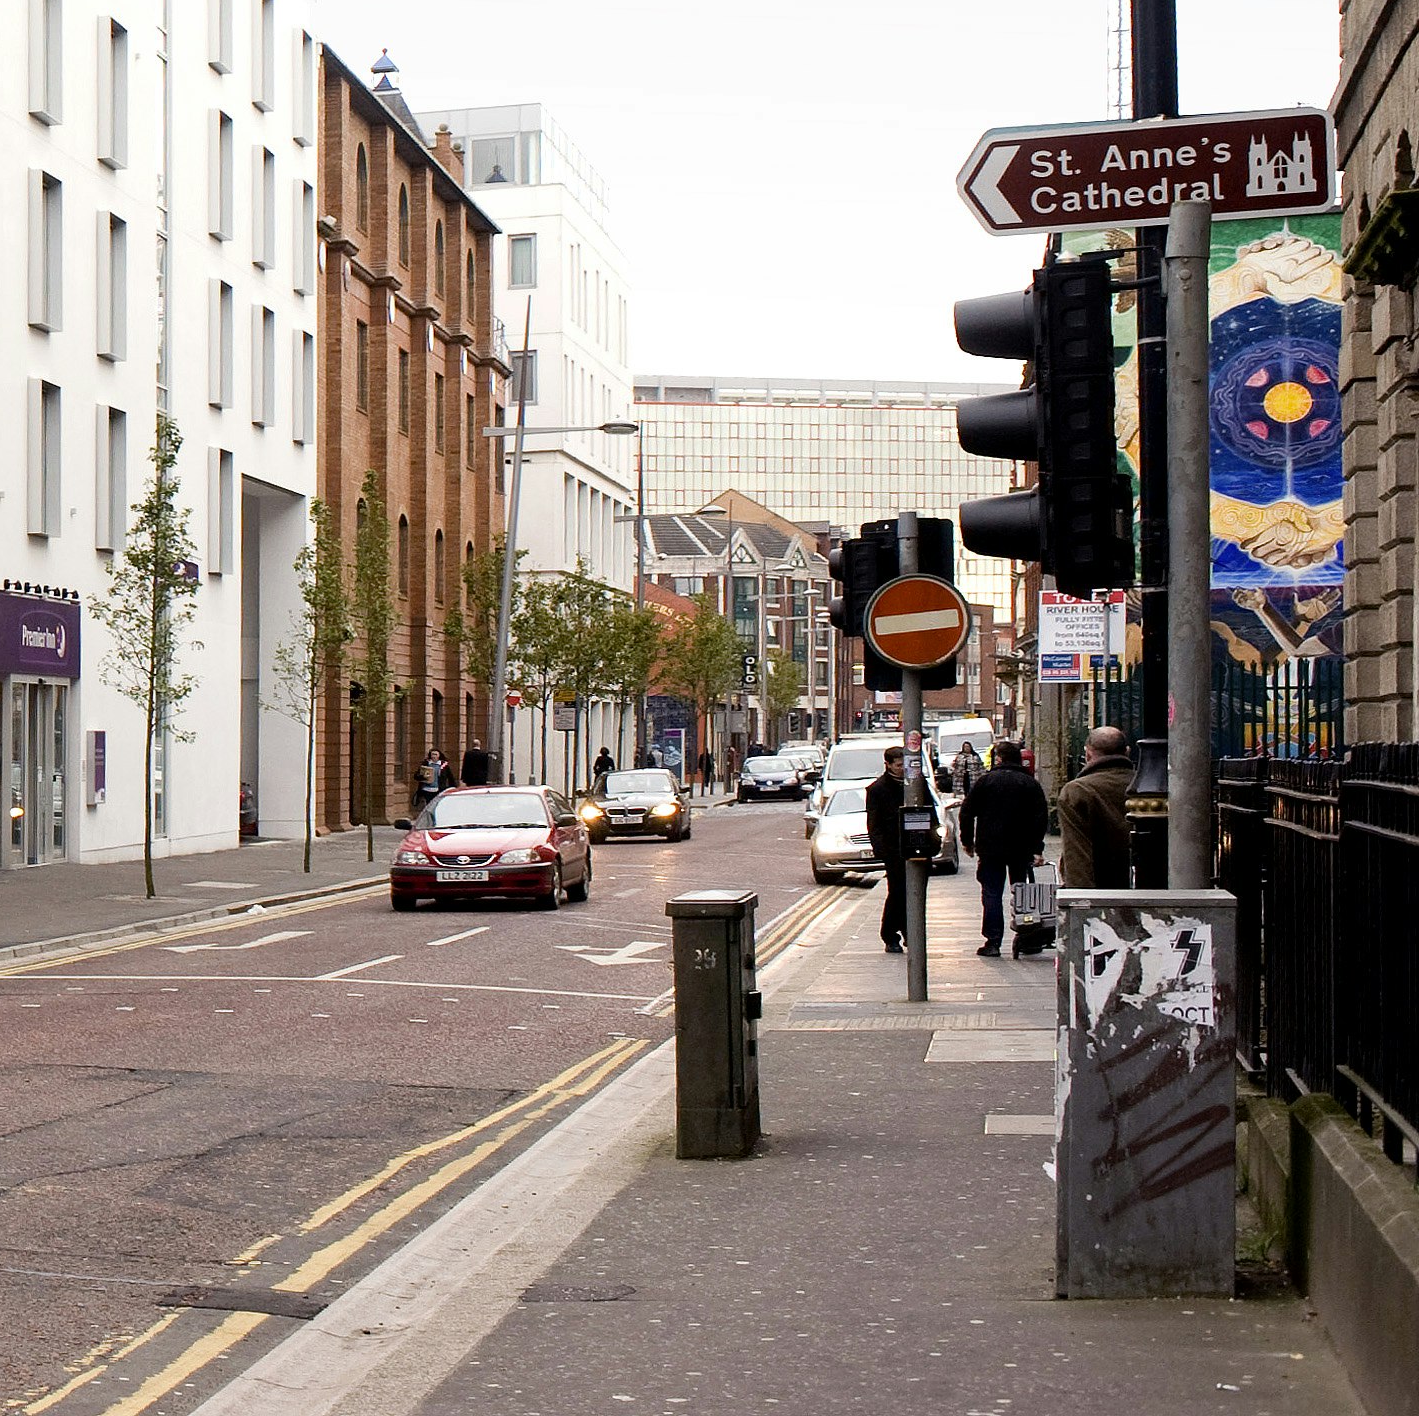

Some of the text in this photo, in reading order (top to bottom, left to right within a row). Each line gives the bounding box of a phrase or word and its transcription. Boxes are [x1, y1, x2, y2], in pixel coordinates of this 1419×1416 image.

[1030, 137, 1232, 178] St. Anne's
[1030, 173, 1225, 214] Cathedral
[1046, 605, 1119, 614] RIVER HOUE
[22, 624, 46, 648] Premier
